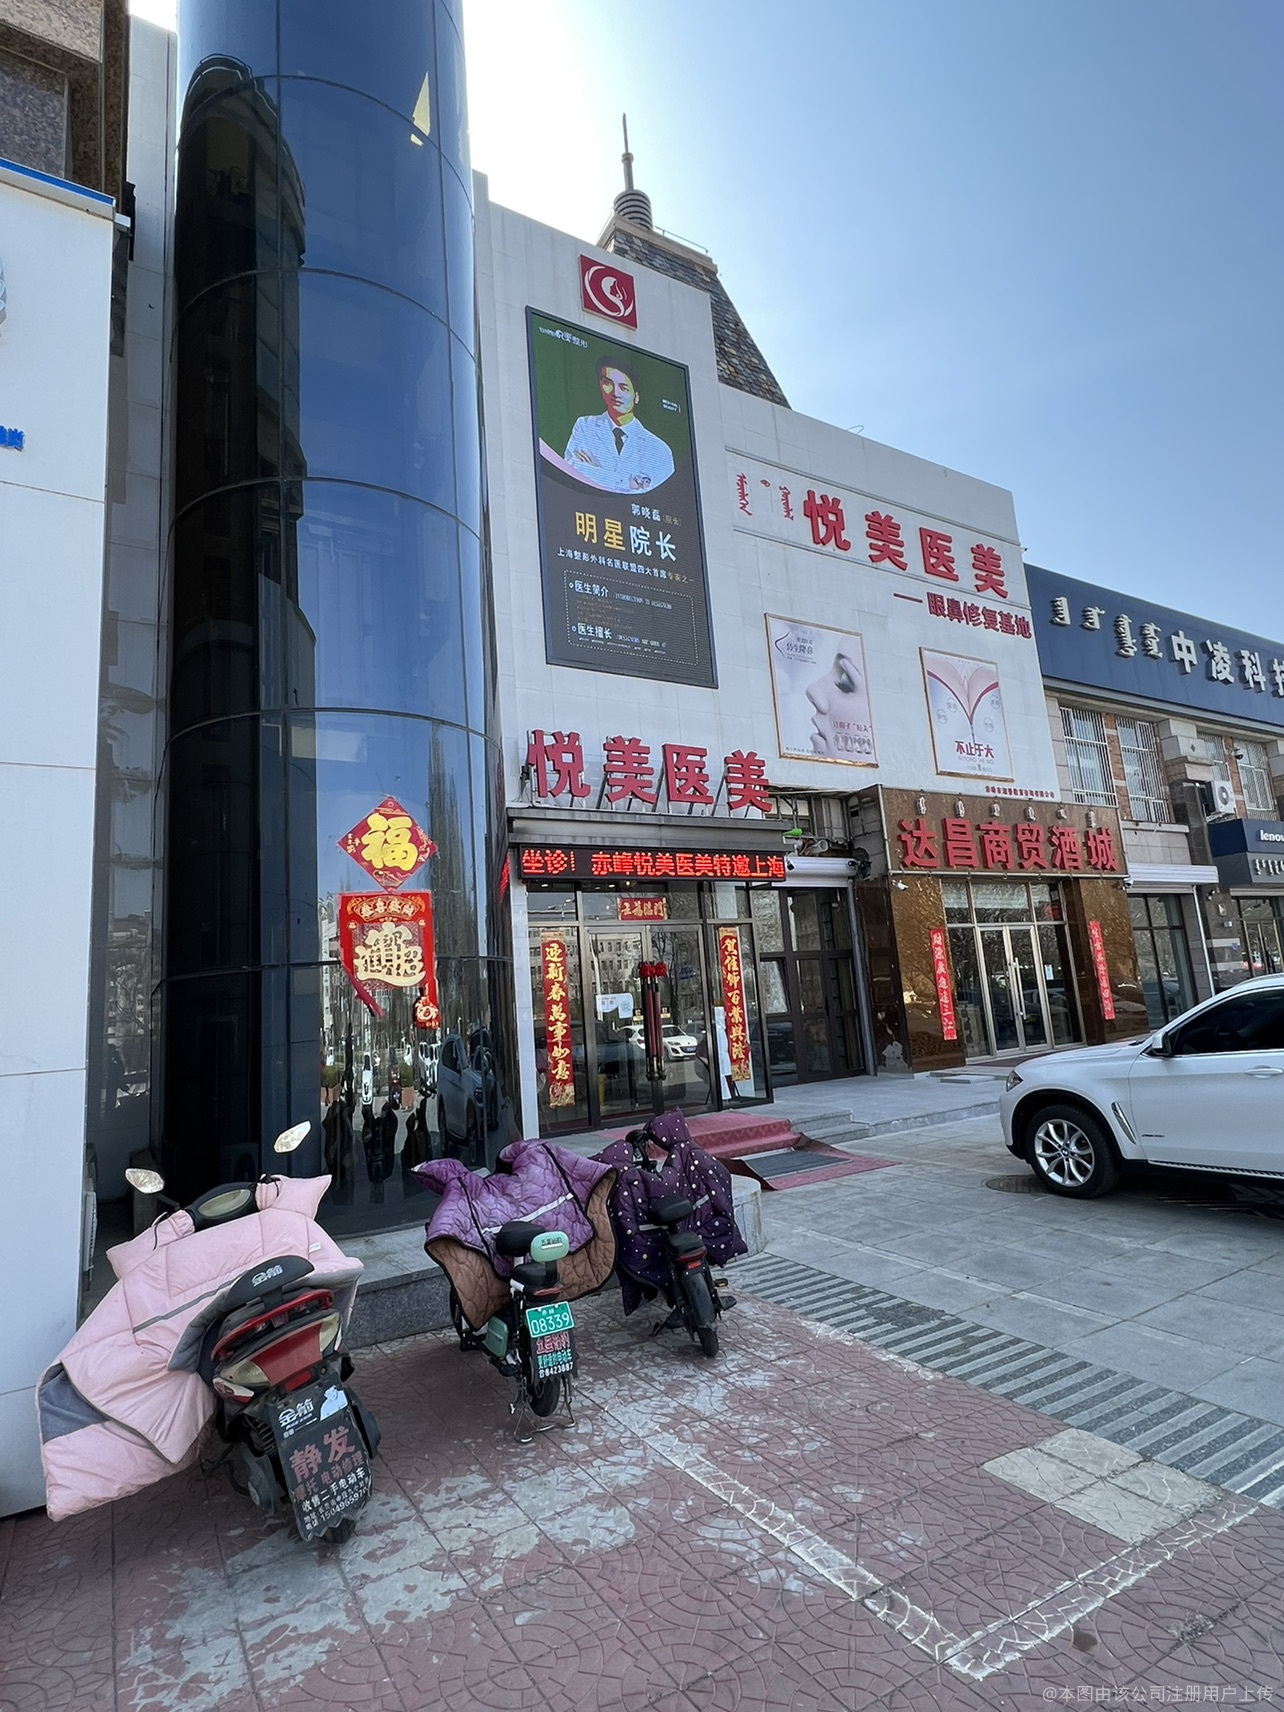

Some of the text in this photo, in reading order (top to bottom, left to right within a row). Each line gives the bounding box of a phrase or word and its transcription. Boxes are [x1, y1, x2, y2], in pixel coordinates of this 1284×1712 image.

[574, 511, 677, 562] 明星院长
[803, 489, 1009, 598] 悦美医美
[574, 579, 609, 598] 医生简介
[577, 622, 612, 640] 医生擅长
[927, 591, 1032, 639] 眼鼻修复基地
[527, 729, 773, 812] 悦美医美
[954, 740, 994, 759] 不止于大
[361, 812, 418, 871] 福
[590, 851, 785, 878] 赤峰悦美医美特邀上海
[899, 817, 1118, 871] 达昌商贸酒城
[531, 1312, 570, 1334] 08339
[301, 1466, 367, 1513] 收售二手电动车
